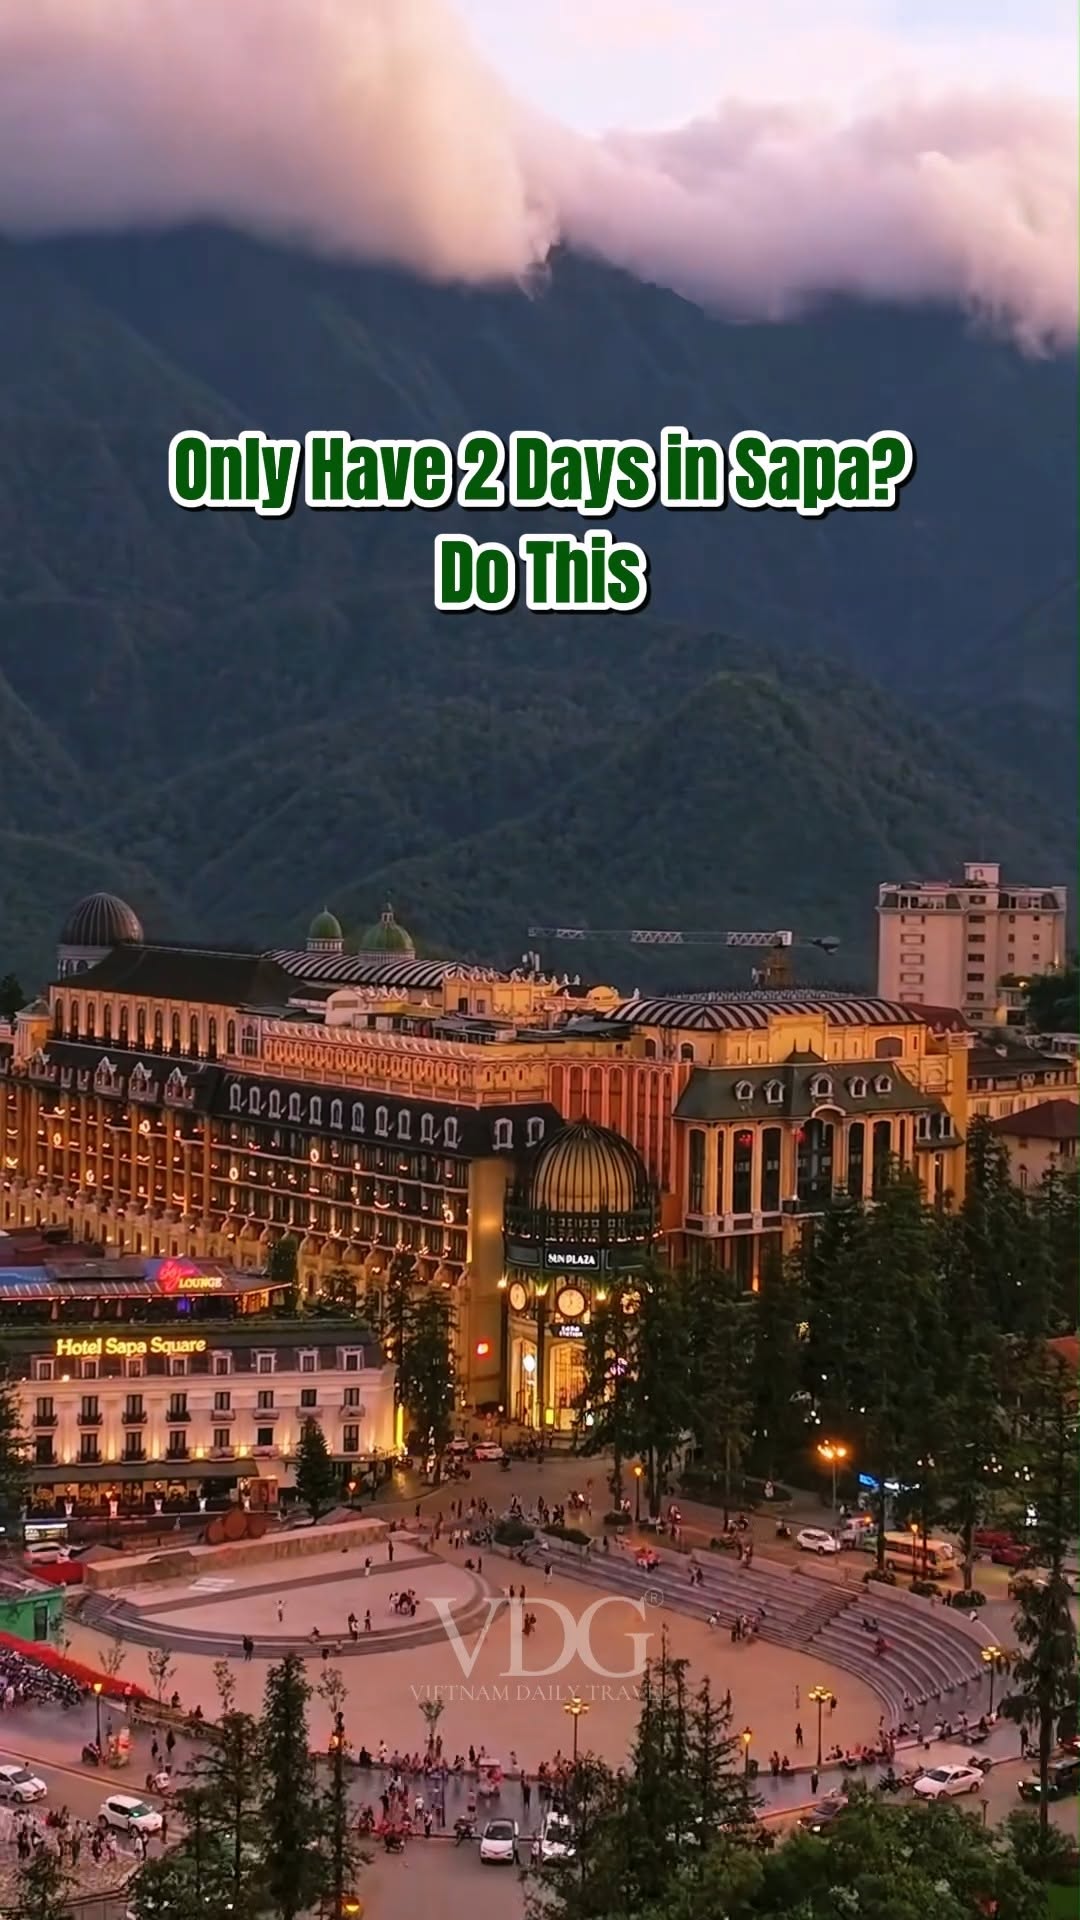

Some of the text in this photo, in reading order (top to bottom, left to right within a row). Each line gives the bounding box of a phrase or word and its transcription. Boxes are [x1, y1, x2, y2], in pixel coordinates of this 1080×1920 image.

[565, 1254, 596, 1265] PLAZA
[178, 1276, 223, 1289] LOUNGE
[56, 1336, 207, 1357] Hotel Sapa Square
